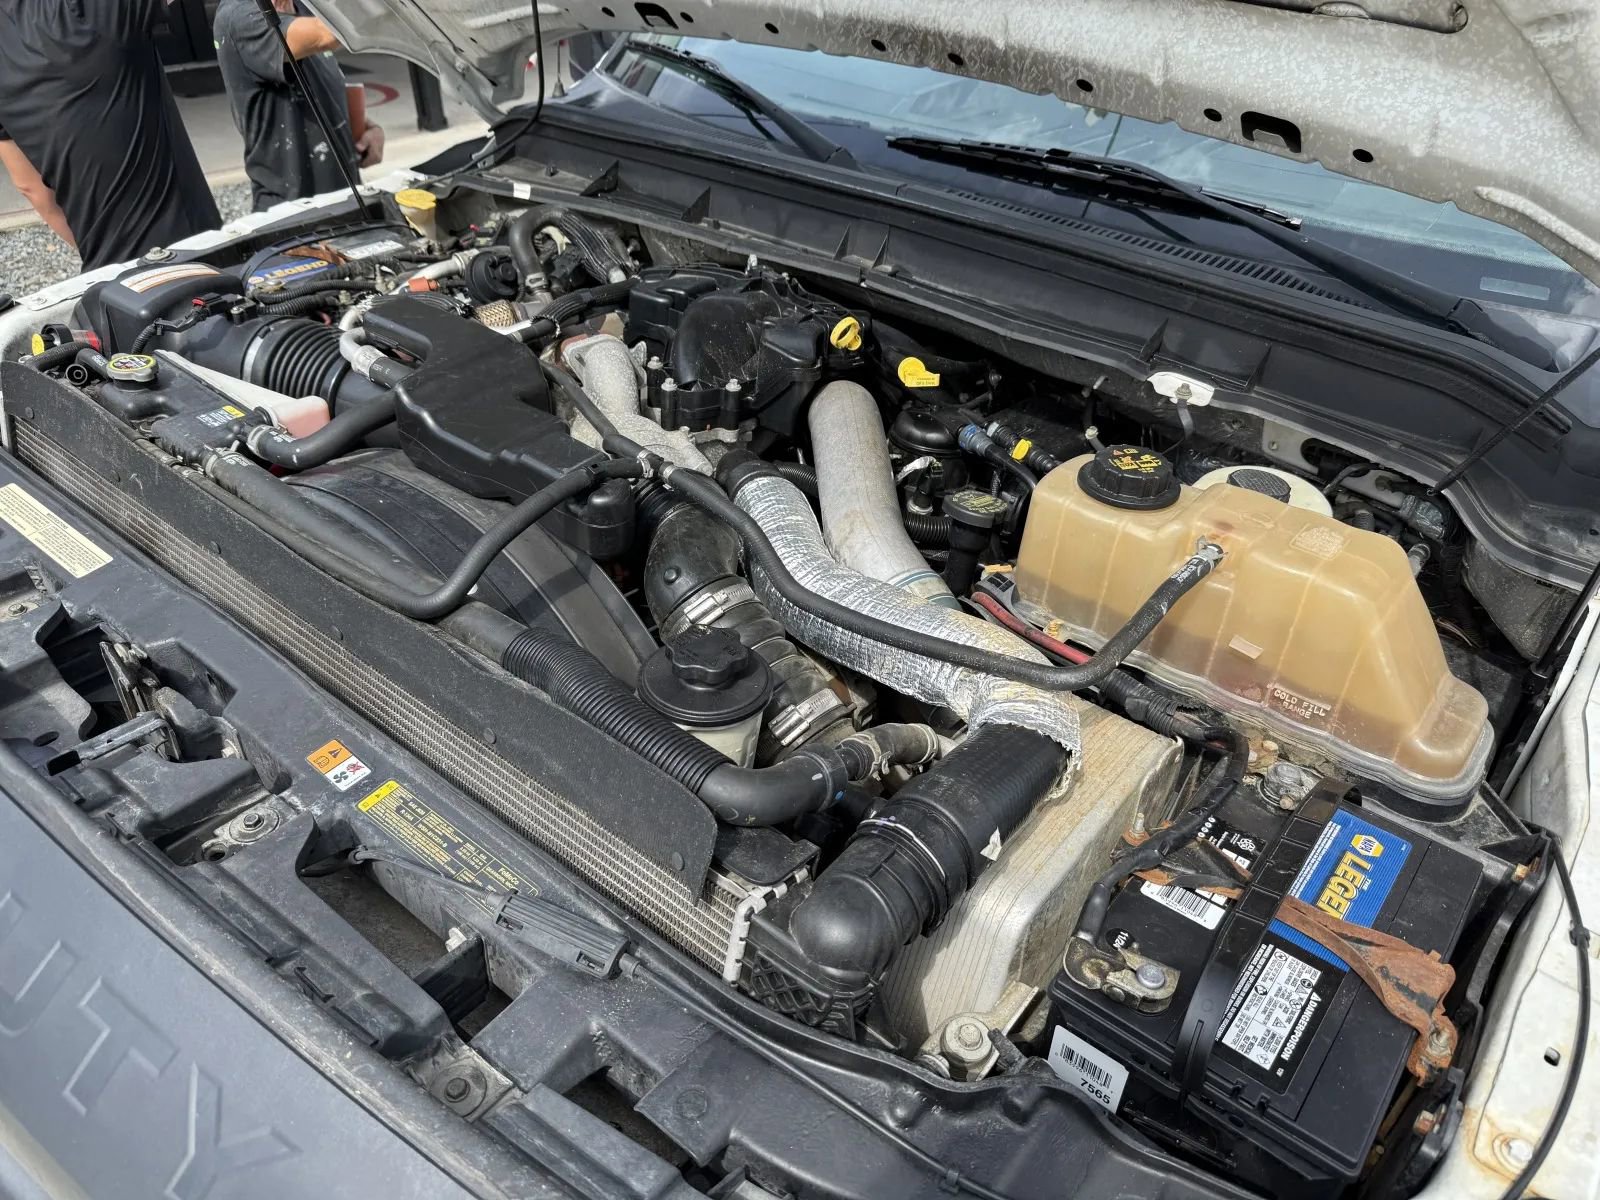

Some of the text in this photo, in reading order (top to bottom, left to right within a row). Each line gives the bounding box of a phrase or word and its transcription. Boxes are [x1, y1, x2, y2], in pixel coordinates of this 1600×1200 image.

[264, 261, 329, 279] LEGEND
[1274, 689, 1326, 716] COLD FILL
[1282, 701, 1311, 718] RANGE
[498, 867, 519, 885] FoMoCo
[1316, 850, 1373, 920] LEGE
[1281, 1000, 1318, 1061] DANGER/POISON
[1081, 1077, 1111, 1104] 7565
